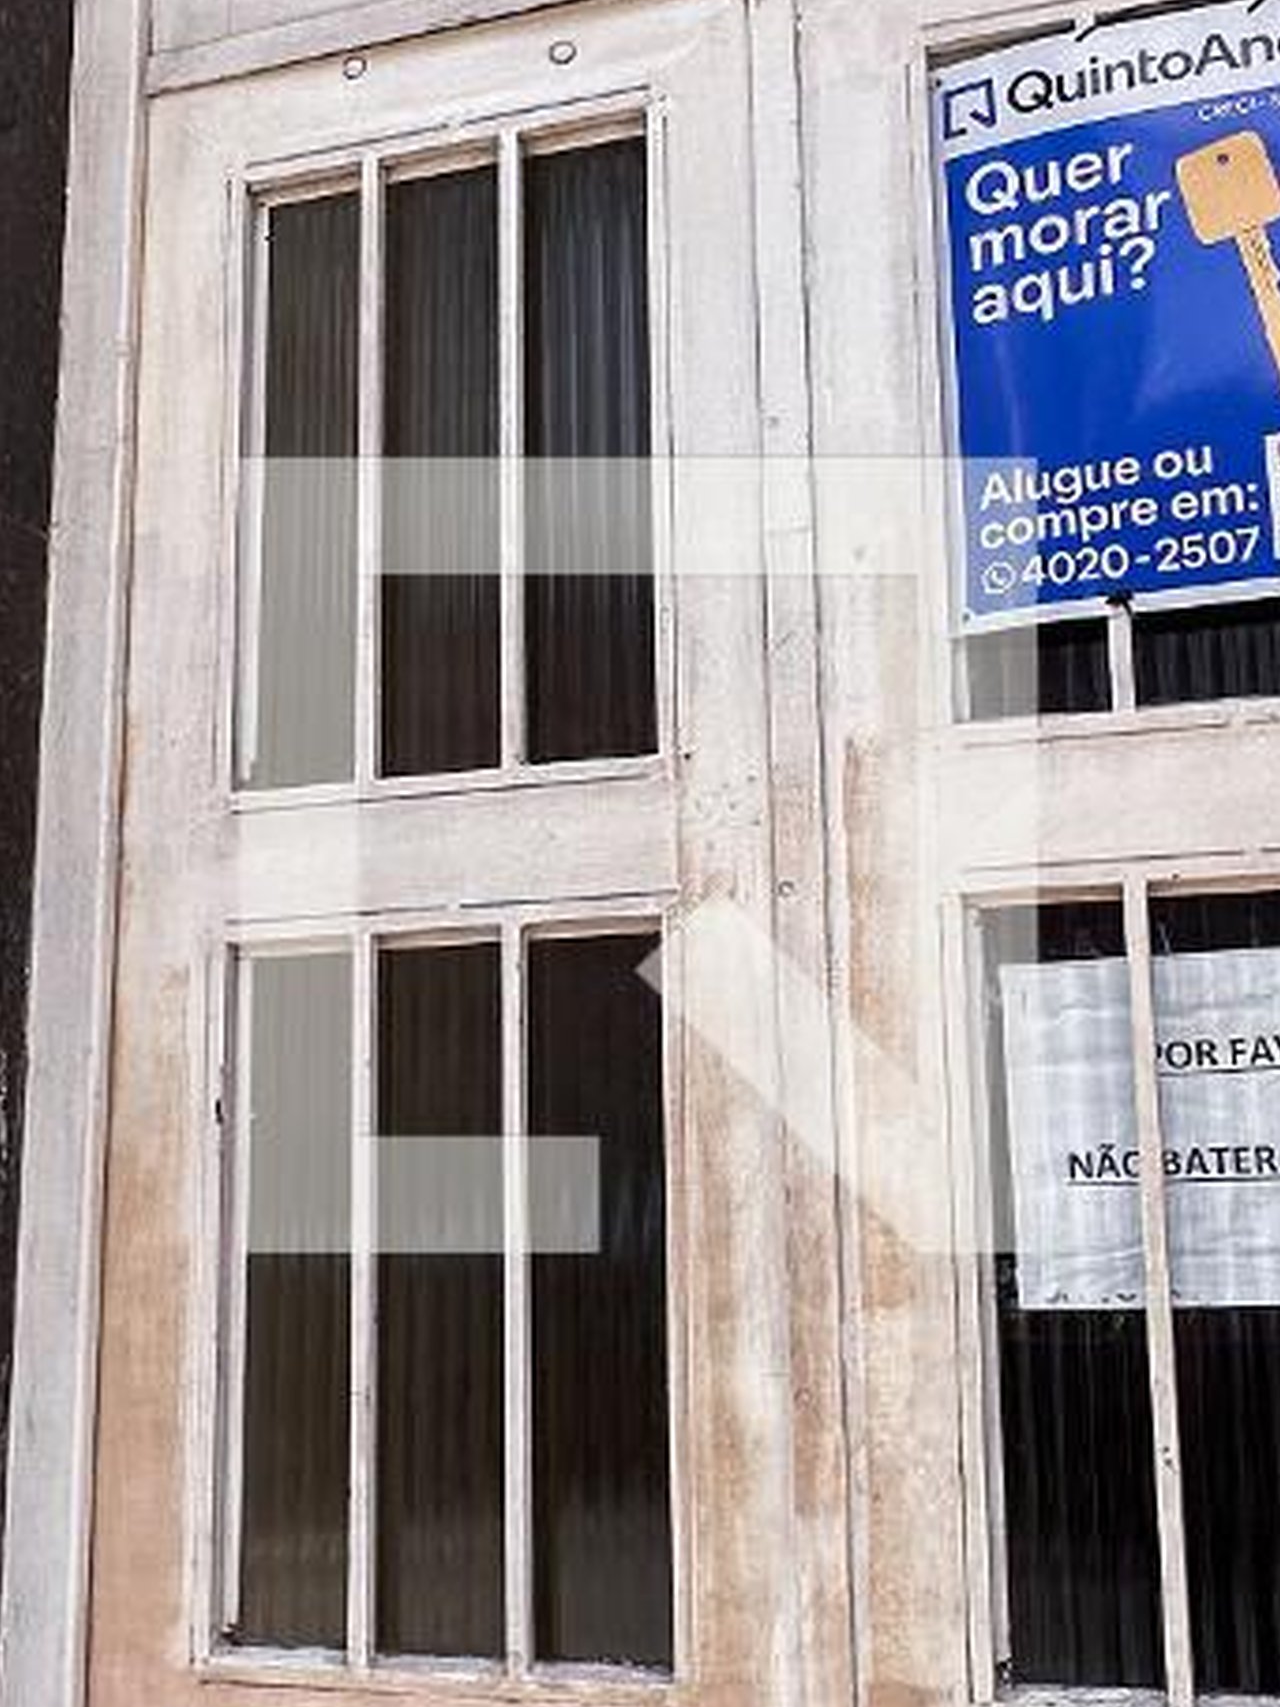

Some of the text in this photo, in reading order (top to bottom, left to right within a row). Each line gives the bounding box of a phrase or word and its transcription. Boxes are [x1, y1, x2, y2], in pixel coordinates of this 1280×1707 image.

[964, 142, 1134, 216] Quer
[967, 190, 1170, 272] morar
[971, 236, 1156, 325] aqui?
[979, 444, 1214, 510] Alugue ou
[979, 478, 1259, 553] compre em:
[1022, 526, 1261, 586] 4020-2507
[1164, 1144, 1278, 1177] BATER
